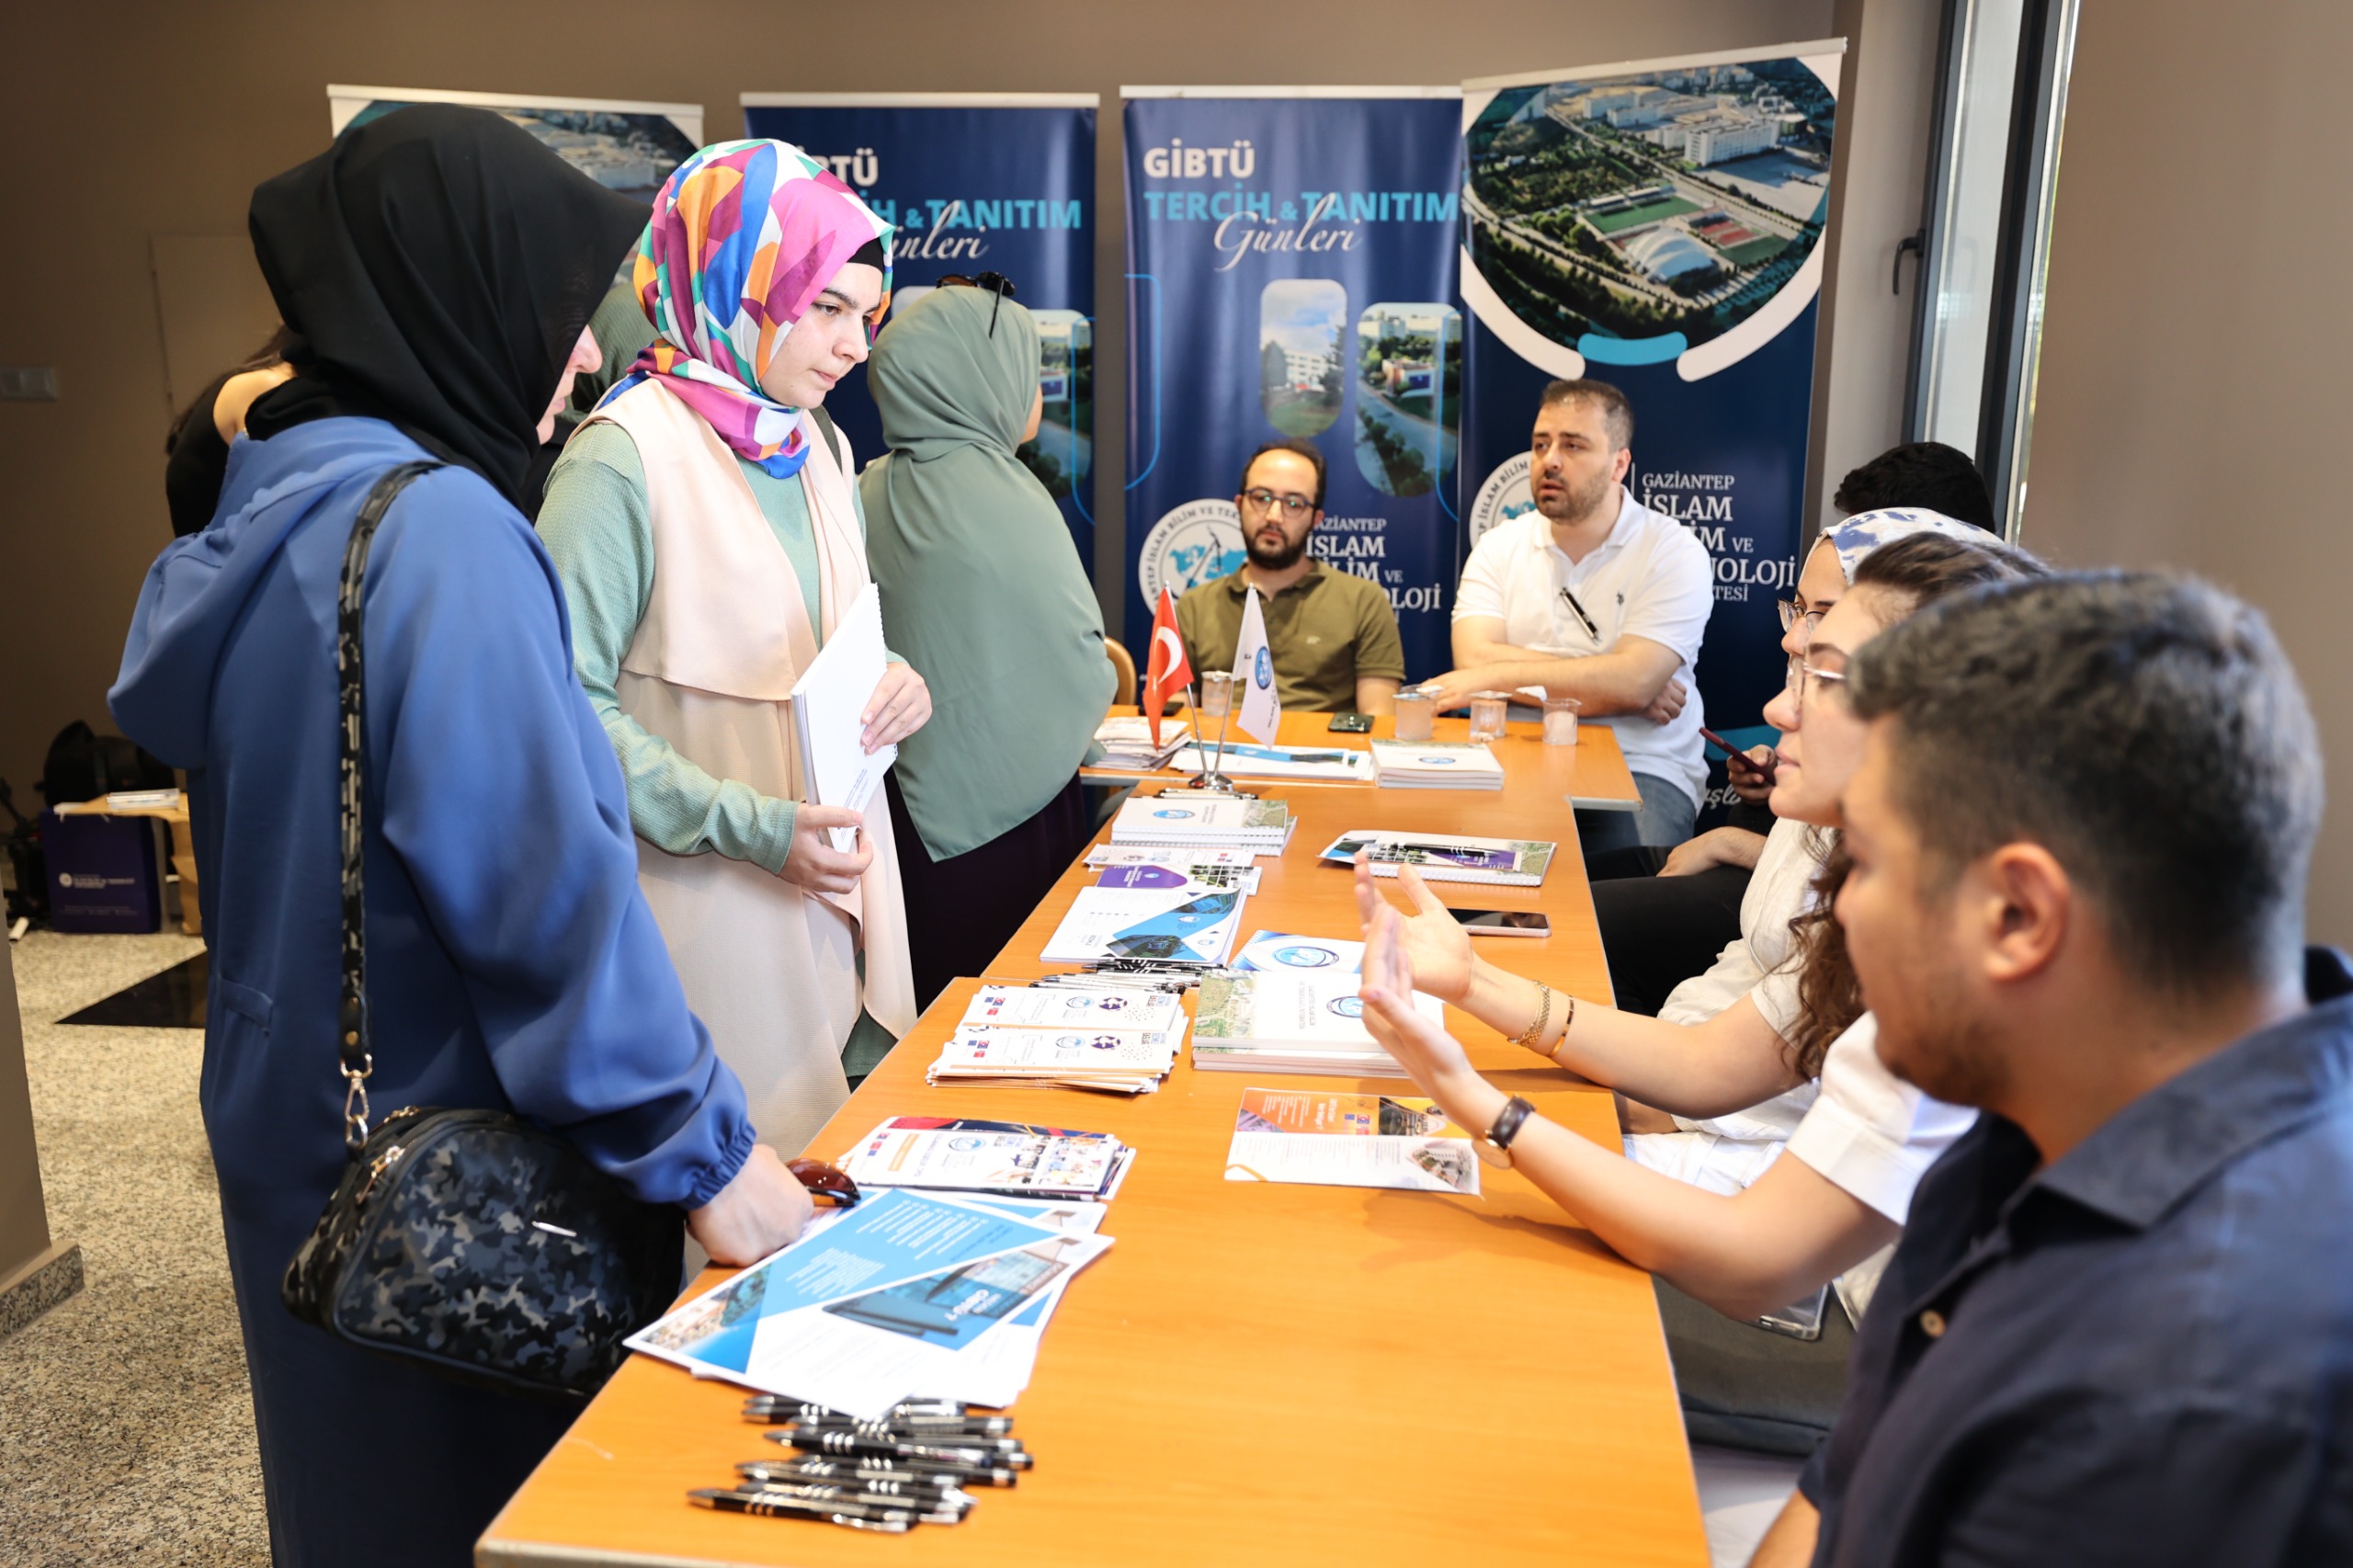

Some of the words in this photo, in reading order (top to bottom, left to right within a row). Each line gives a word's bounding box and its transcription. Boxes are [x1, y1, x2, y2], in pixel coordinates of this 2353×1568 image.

[1143, 137, 1255, 178] GİBTÜ
[925, 199, 1082, 229] TANITIM
[1142, 181, 1270, 222] TERCİH
[1279, 200, 1299, 222] &
[1301, 191, 1458, 222] TANITIM
[1213, 191, 1363, 273] Günleri
[1642, 471, 1735, 491] GAZİANTEP
[1643, 487, 1733, 522] İSLAM
[1313, 515, 1387, 532] AZİANTEP
